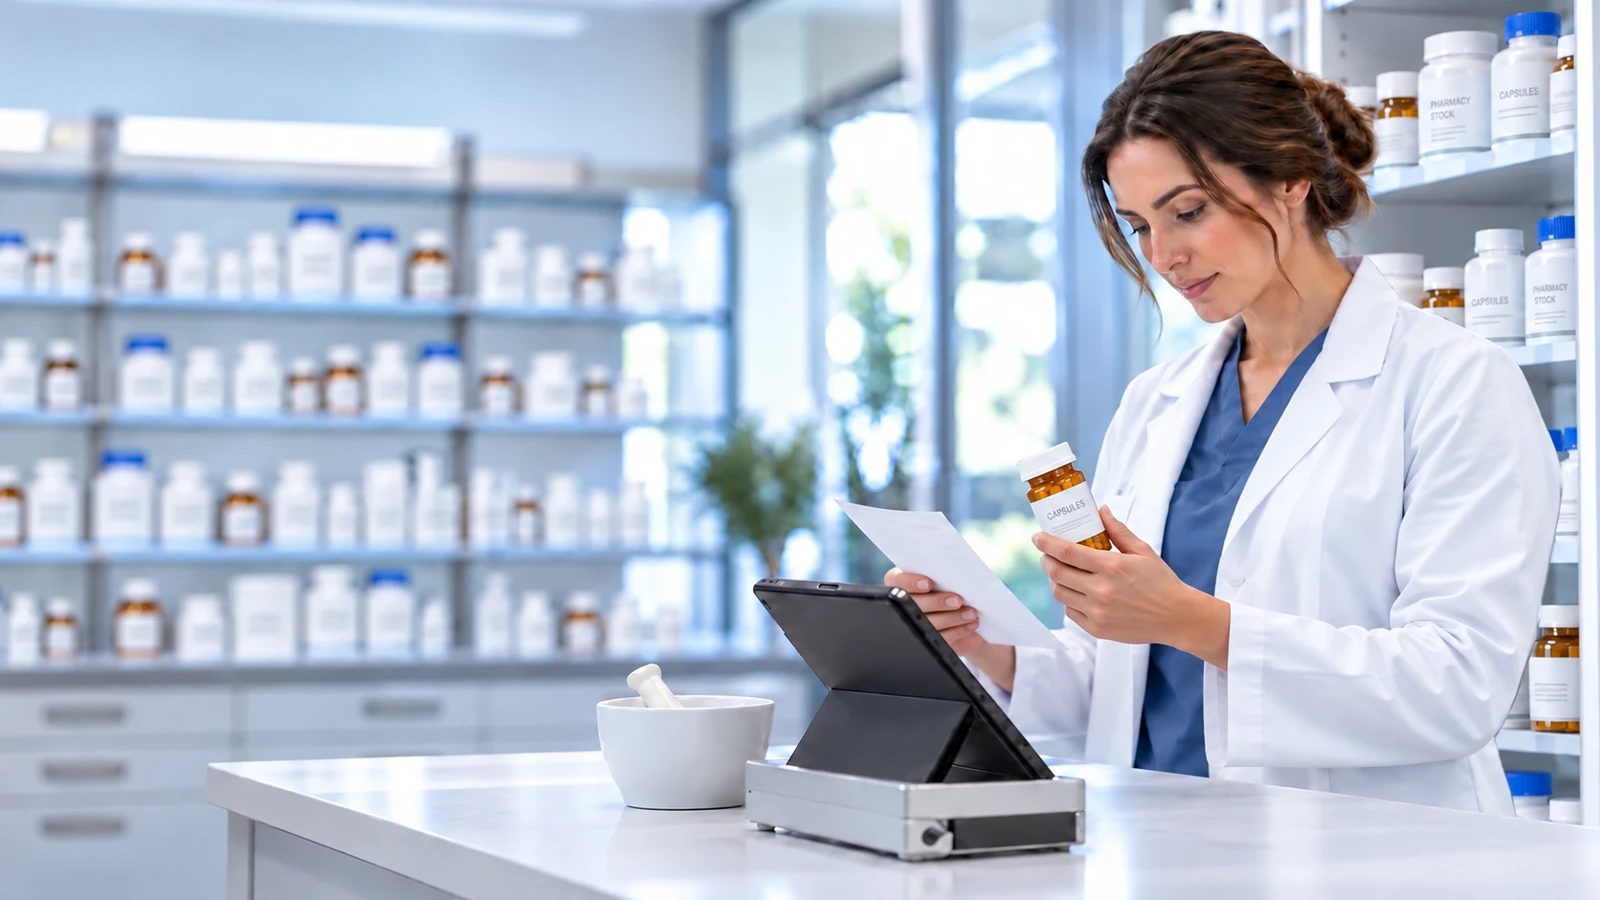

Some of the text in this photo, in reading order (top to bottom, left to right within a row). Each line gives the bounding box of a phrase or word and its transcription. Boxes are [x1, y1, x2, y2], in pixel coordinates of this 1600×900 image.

[1499, 87, 1539, 100] CAPSULES
[1430, 96, 1471, 109] PHARMACY
[1430, 110, 1455, 121] STOCK
[1533, 283, 1568, 294] PHARMACY
[1471, 296, 1509, 307] CAPSULES
[1535, 295, 1556, 305] STOCK
[1046, 499, 1086, 521] CAPSULES
